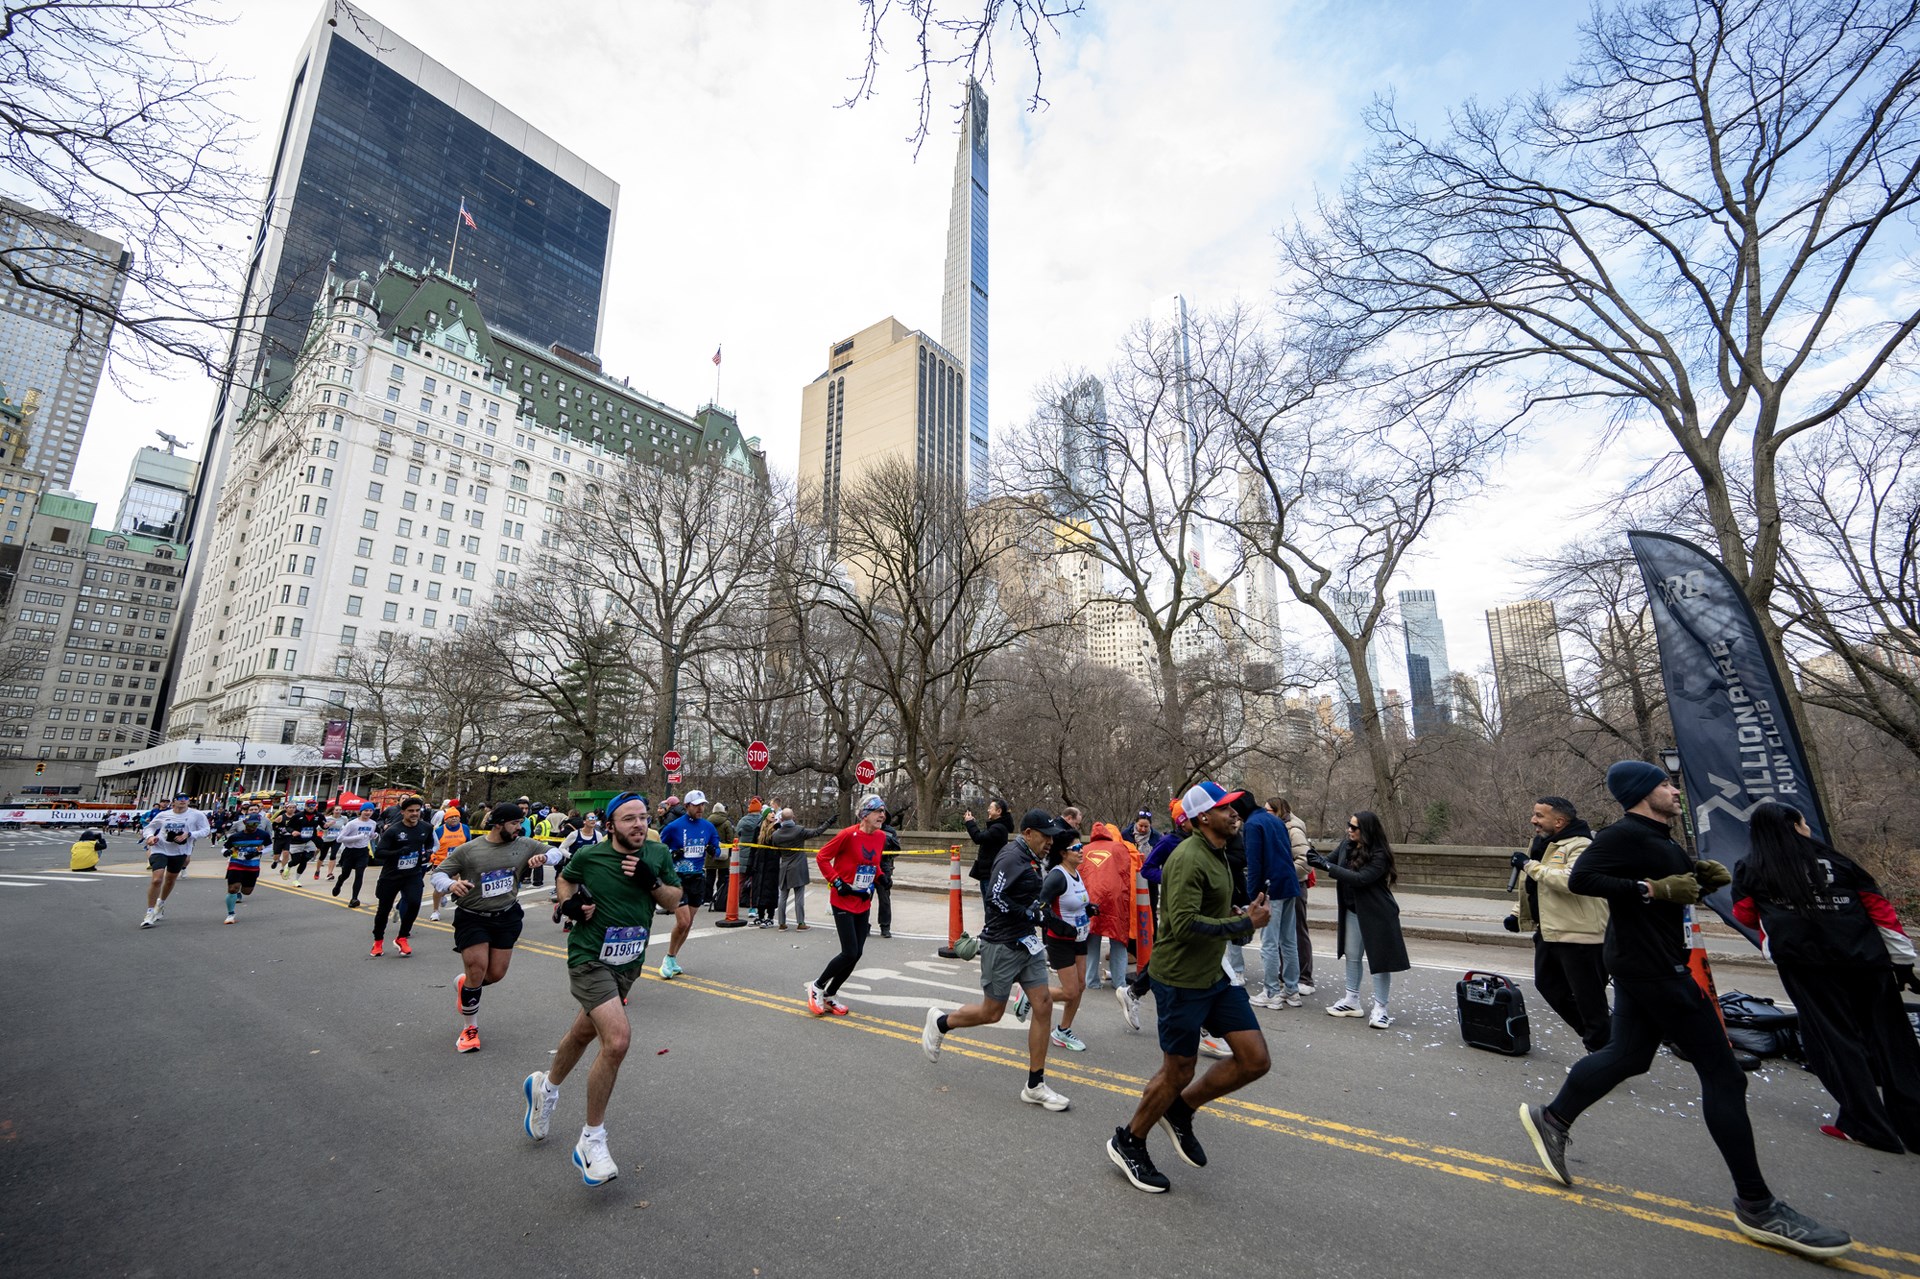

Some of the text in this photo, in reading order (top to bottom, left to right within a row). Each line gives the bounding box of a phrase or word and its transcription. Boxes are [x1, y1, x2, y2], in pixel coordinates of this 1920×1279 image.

[1755, 699, 1798, 794] RUN CLUB
[664, 756, 681, 765] STOP
[748, 751, 768, 762] STOP
[856, 765, 875, 778] STOP
[51, 810, 76, 819] Run
[484, 877, 513, 892] D18735
[1832, 896, 1850, 904] CLUB
[604, 941, 642, 957] D19812
